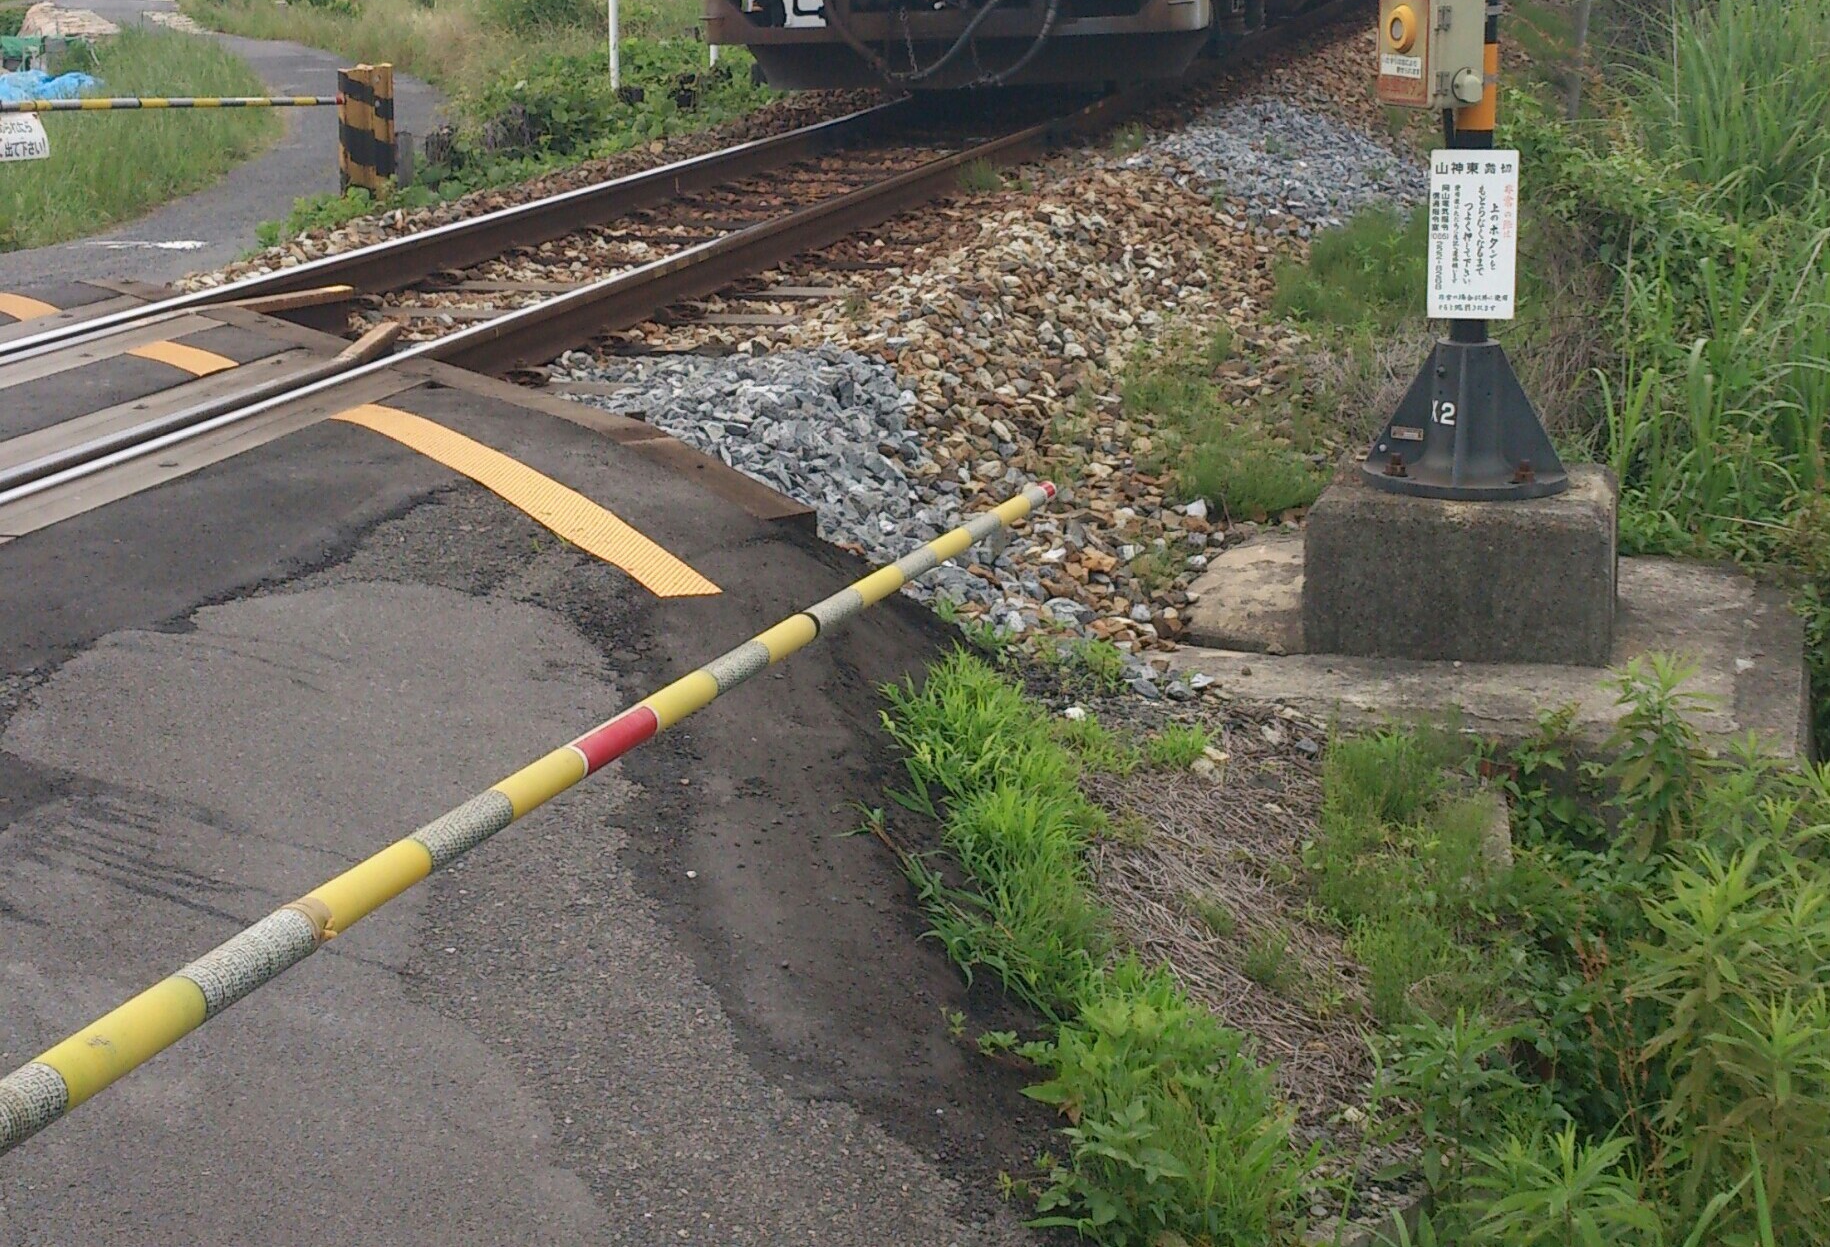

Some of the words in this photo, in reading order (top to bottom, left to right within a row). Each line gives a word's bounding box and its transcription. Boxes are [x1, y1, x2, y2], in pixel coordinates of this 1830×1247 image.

[0, 121, 33, 134] られたら
[0, 138, 46, 157] 出て下さい!
